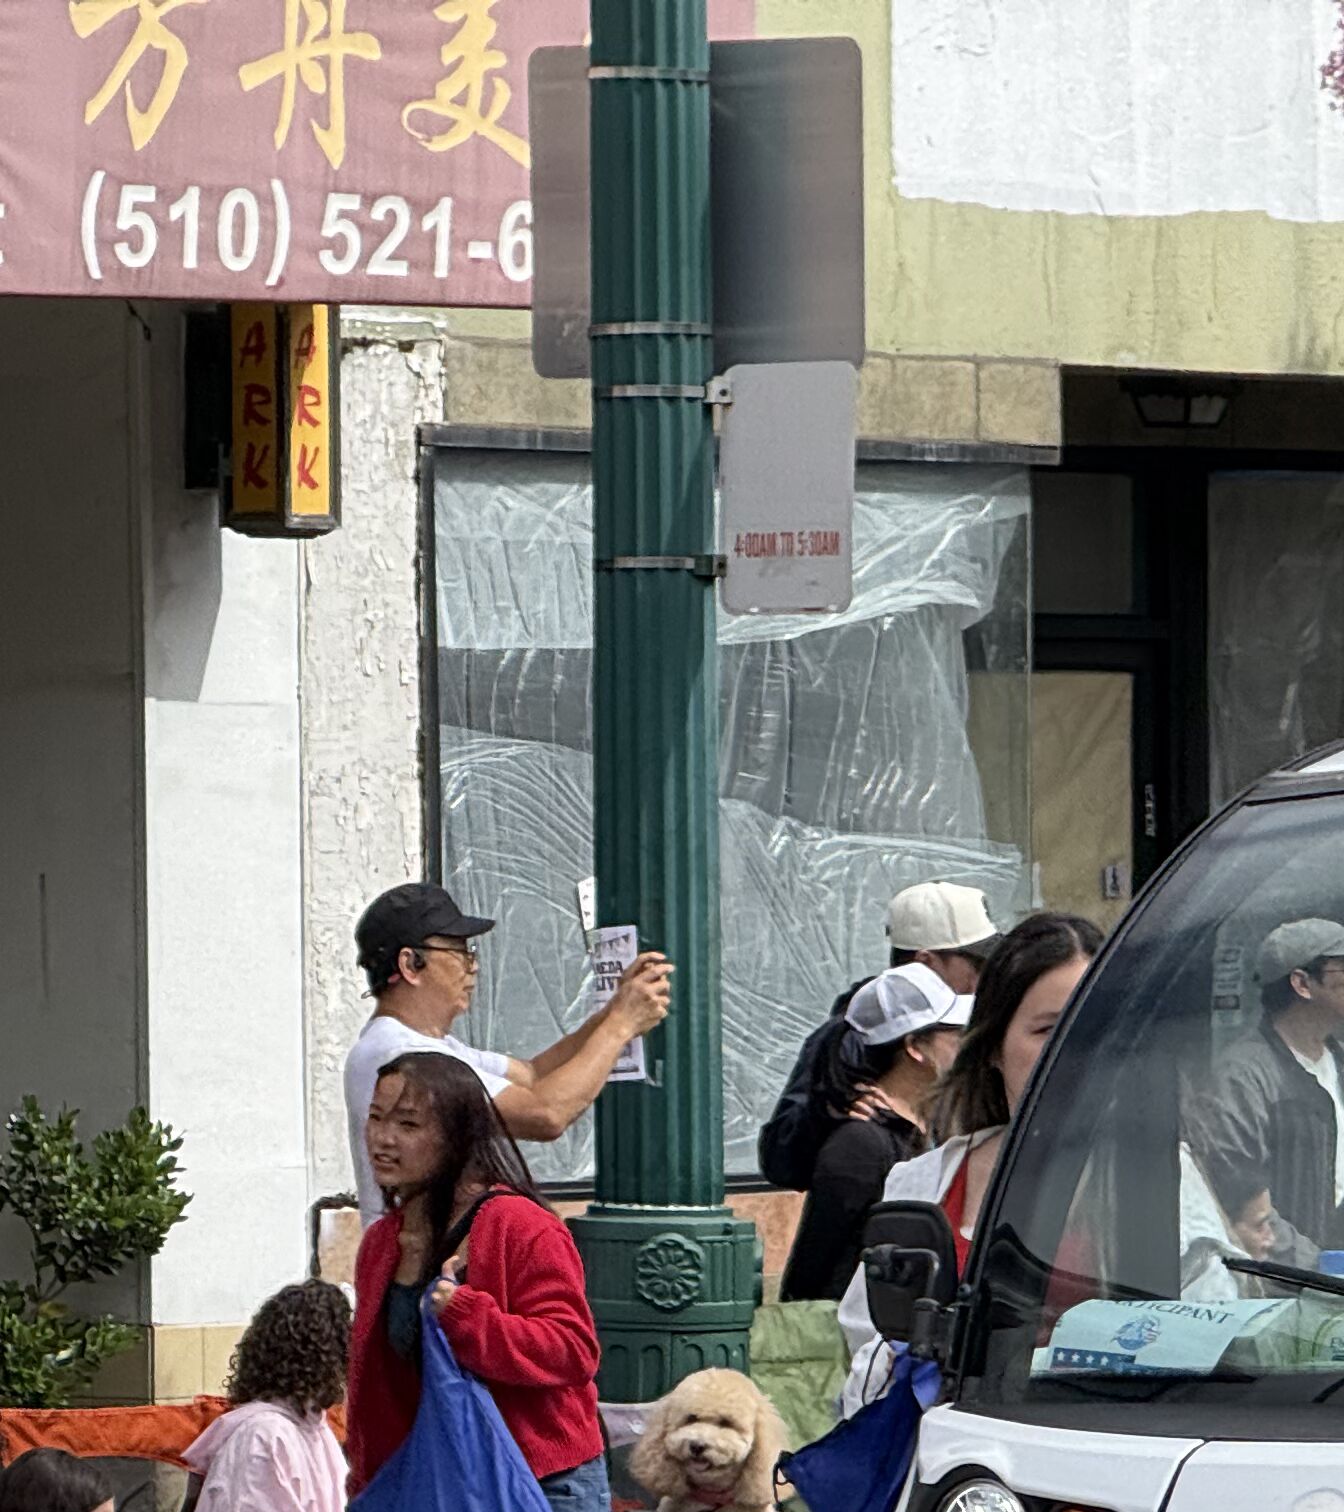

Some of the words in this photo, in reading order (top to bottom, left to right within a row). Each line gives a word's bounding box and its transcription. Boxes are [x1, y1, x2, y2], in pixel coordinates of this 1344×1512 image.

[81, 170, 291, 286] (510)
[239, 320, 273, 491] ARK
[293, 322, 321, 491] ARK
[779, 531, 795, 557] TO
